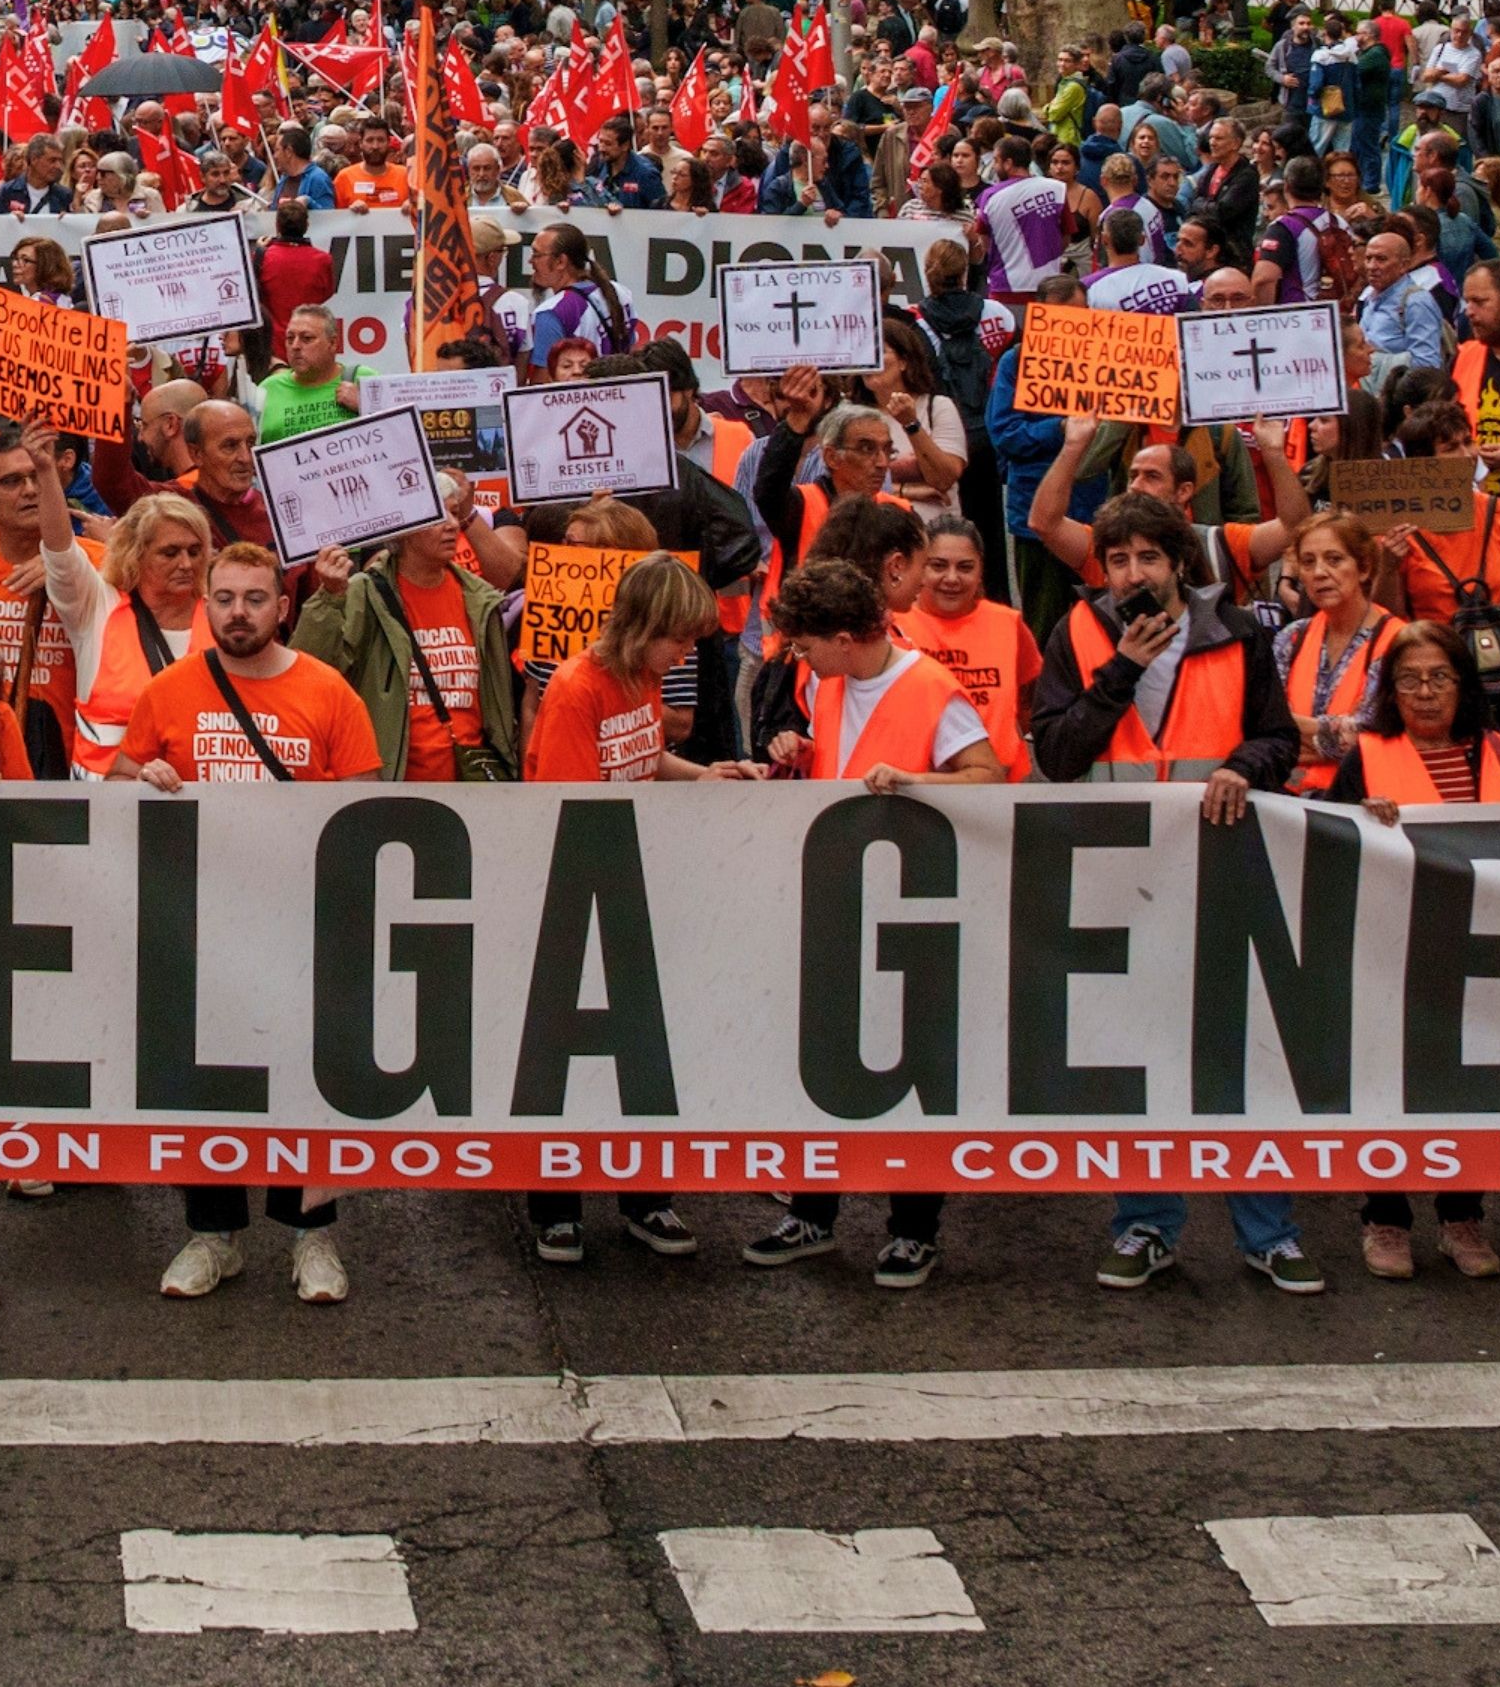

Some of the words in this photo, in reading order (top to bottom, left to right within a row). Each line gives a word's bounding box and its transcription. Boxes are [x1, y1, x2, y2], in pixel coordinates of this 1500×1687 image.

[124, 242, 148, 257] LA
[154, 228, 209, 251] emvs
[755, 274, 778, 287] LA
[787, 270, 842, 285] emvs
[735, 322, 760, 332] NOS
[814, 320, 830, 330] LA
[832, 315, 867, 329] VIDA
[1213, 322, 1236, 335] LA
[1245, 315, 1300, 332] emvs
[1026, 334, 1094, 360] VUELVE
[1098, 342, 1109, 362] A
[30, 339, 122, 385] INQUILINAS
[1023, 357, 1088, 384] ESTAS
[1095, 365, 1158, 392] CASAS
[1194, 370, 1221, 382] NOS
[1275, 365, 1291, 375] LA
[1292, 358, 1329, 374] VIDA
[72, 380, 100, 406] TU
[543, 388, 627, 407] CARABANCHEL
[1025, 383, 1068, 410] SON
[294, 448, 320, 466] LA
[326, 428, 383, 456] emvs
[299, 472, 321, 484] NOS
[323, 455, 372, 477] ARRUINÓ
[373, 452, 388, 462] LA
[559, 462, 610, 476] RESISTE
[327, 474, 369, 496] VIDA
[530, 578, 567, 603] VAS
[580, 583, 593, 606] A
[533, 631, 569, 660] EN
[198, 737, 216, 756] DE
[600, 744, 616, 763] DE
[149, 1132, 494, 1178] FONDOS
[540, 1137, 842, 1181] BUITRE
[951, 1139, 1463, 1180] CONTRATOS
